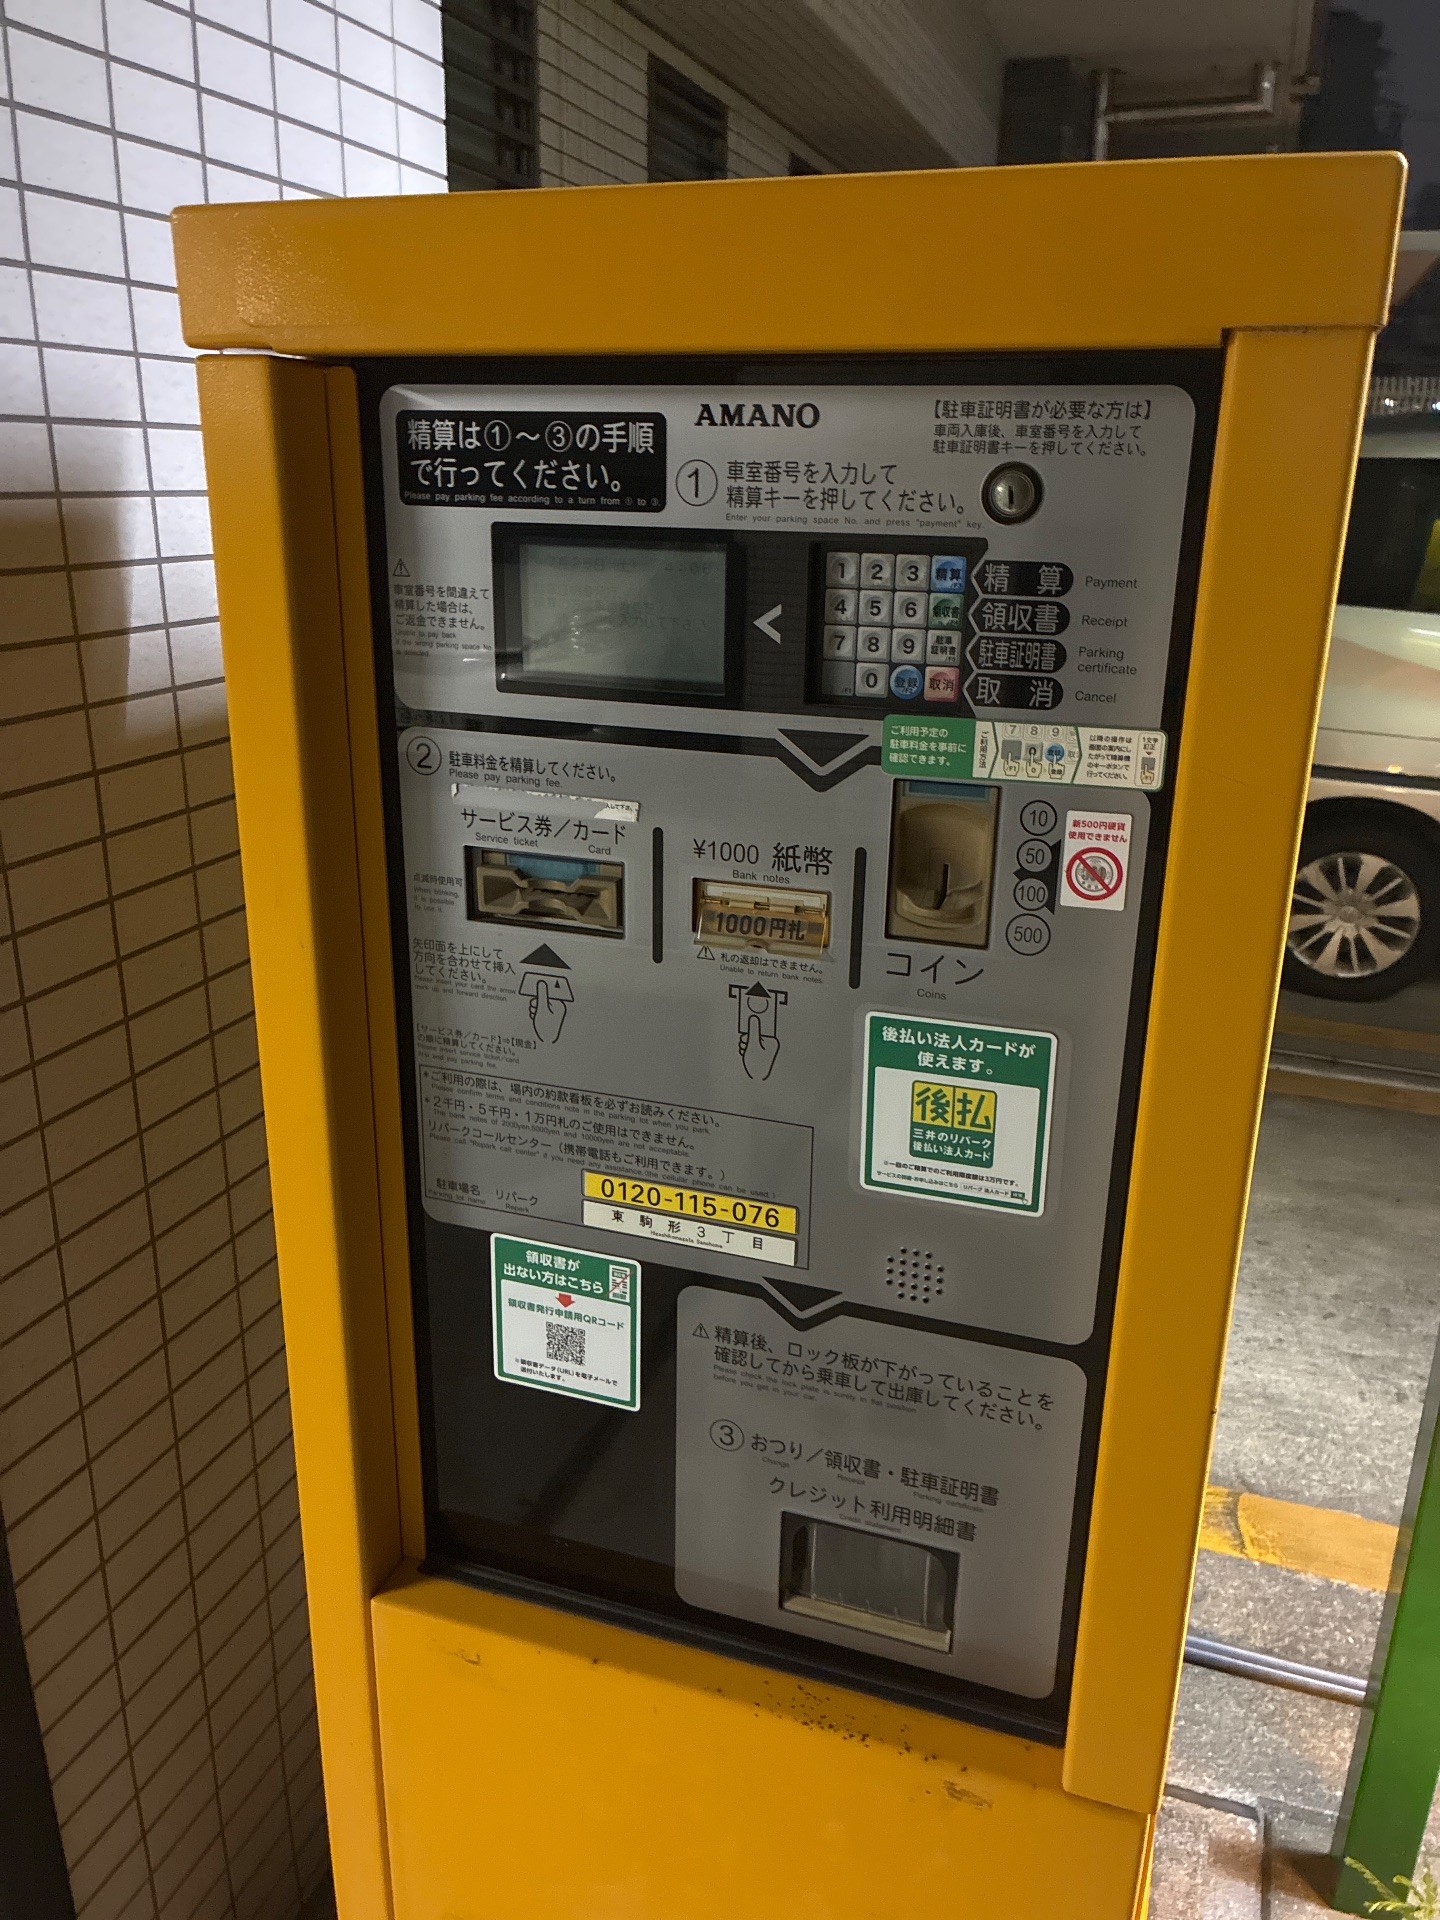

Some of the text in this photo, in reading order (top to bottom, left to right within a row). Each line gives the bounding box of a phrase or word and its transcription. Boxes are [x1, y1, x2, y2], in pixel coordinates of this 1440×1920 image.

[694, 402, 820, 429] AMANO
[410, 456, 621, 492] で行ってください。
[726, 460, 897, 485] 車室番号を入力して
[404, 490, 431, 500] Please
[435, 492, 450, 503] pay
[454, 491, 486, 504] parking
[490, 493, 504, 503] fee
[508, 493, 550, 506] according
[600, 496, 621, 506] from
[726, 486, 964, 514] 精算キーを押してください。
[725, 513, 748, 522] Enter
[752, 514, 771, 524] your
[776, 514, 808, 526] parking
[813, 516, 839, 526] space
[864, 517, 880, 526] and
[886, 518, 911, 528] press
[838, 563, 845, 579] 1
[871, 563, 883, 580] 2
[907, 564, 919, 581] 3
[1085, 575, 1138, 589] Payment
[835, 599, 847, 615] 4
[869, 600, 881, 616] 5
[905, 601, 917, 618] 6
[982, 601, 1060, 633] 領収書
[1081, 614, 1128, 630] Receipt
[834, 635, 845, 651] 7
[867, 636, 879, 652] 8
[902, 638, 915, 654] 9
[978, 639, 1057, 671] 駐車証明書
[1078, 646, 1124, 661] Parking
[1077, 662, 1137, 675] certificate
[865, 672, 878, 688] 0
[929, 678, 954, 691] 取消
[1075, 690, 1116, 703] Cancel
[891, 725, 949, 738] ご利用予定の
[1030, 725, 1039, 736] 8
[1052, 727, 1060, 737] 9
[449, 750, 616, 783] 駐車料金を精算してください。
[449, 768, 479, 781] Please
[484, 772, 500, 784] pay
[506, 774, 541, 788] parking
[461, 808, 626, 845] サービス券／カード
[1030, 810, 1048, 827] 10
[475, 831, 539, 848] Service ticket
[1068, 832, 1128, 843] 使用できません
[588, 844, 611, 856] Card
[693, 838, 834, 876] ¥1000 紙幣
[1025, 848, 1045, 865] 50
[732, 869, 790, 885] Bank notes
[1018, 885, 1046, 903] 100
[716, 912, 805, 941] 1000円札
[1013, 925, 1043, 944] 500
[886, 952, 984, 985] コイン
[916, 988, 946, 1000] Coins
[882, 1025, 1036, 1060] 後払い法人カードが
[917, 1051, 993, 1075] 使えます。
[916, 1086, 992, 1129] 後払
[912, 1128, 992, 1148] 三井のリパーク
[912, 1141, 992, 1162] 後払い法人カード
[495, 1188, 538, 1207] リパーク
[601, 1178, 780, 1228] 0120-115-076
[525, 1249, 581, 1272] 領収書が
[503, 1262, 604, 1294] 出ない方はこちら
[508, 1297, 624, 1331] 領収書発行申請用QRコード
[714, 1345, 1043, 1431] 確認してから乗車して出庫してください。
[768, 1476, 978, 1543] クレジット利用明細書
